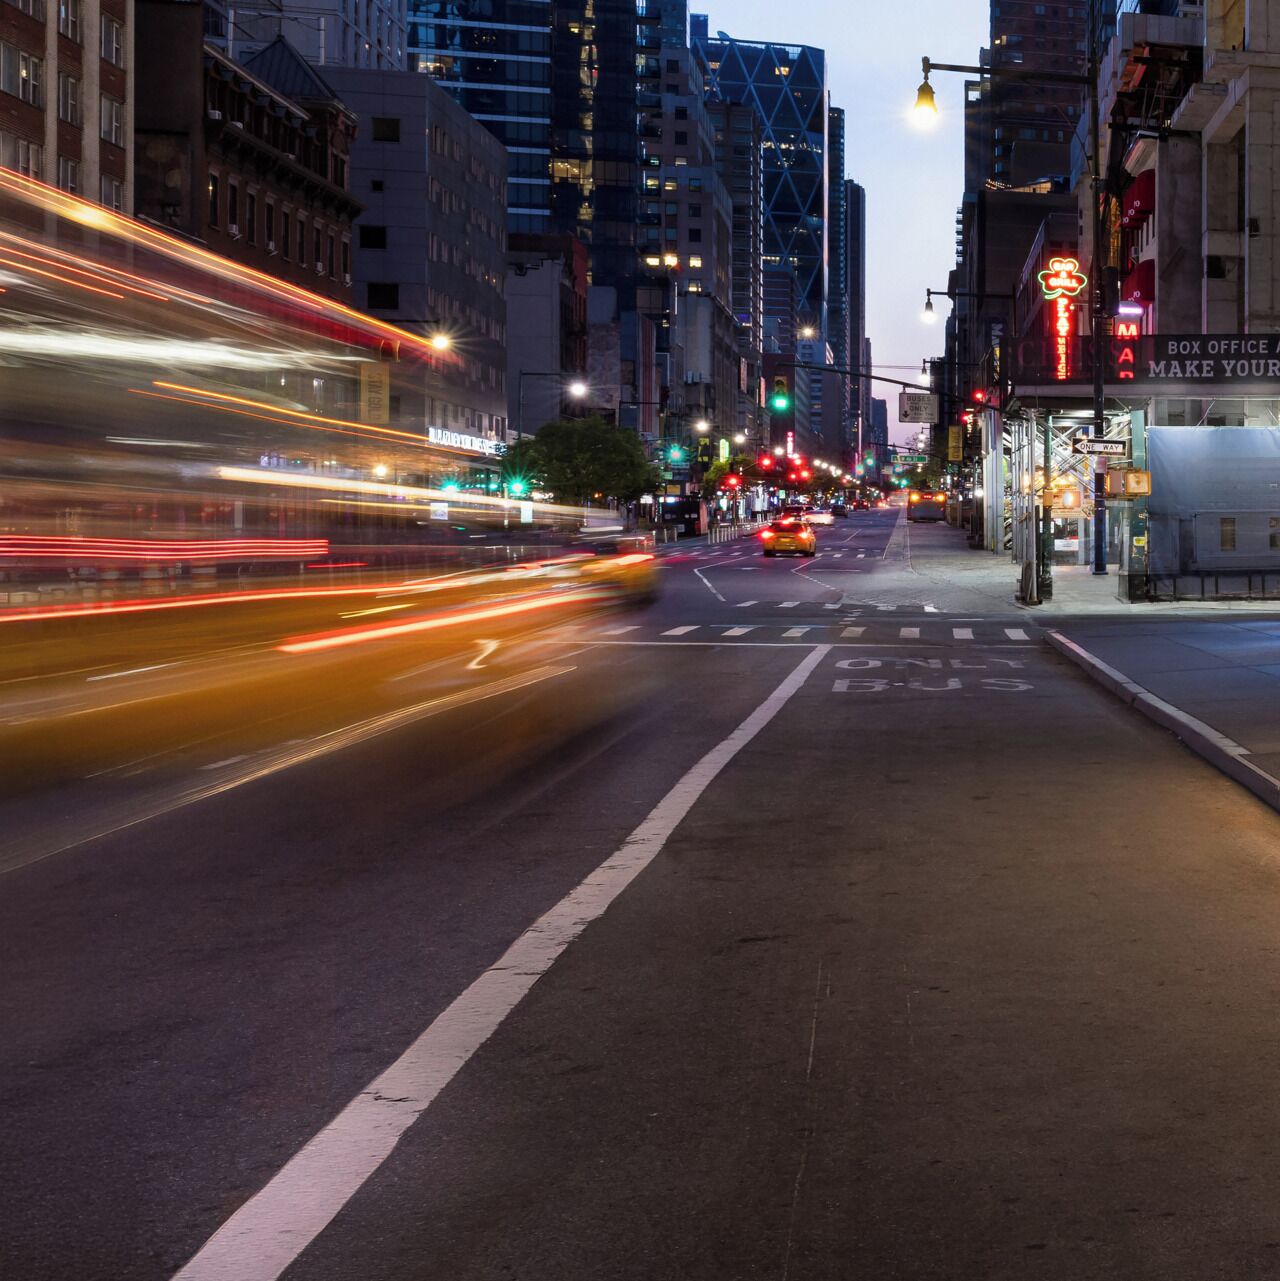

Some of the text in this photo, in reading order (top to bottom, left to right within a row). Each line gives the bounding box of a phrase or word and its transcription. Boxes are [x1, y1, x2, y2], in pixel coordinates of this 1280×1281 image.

[1048, 279, 1079, 287] GRILL
[1168, 341, 1200, 355] BOX
[1208, 340, 1269, 355] OFFICE
[1148, 361, 1214, 378] MAKE
[1222, 360, 1280, 377] YOUR
[832, 678, 1035, 692] BUS
